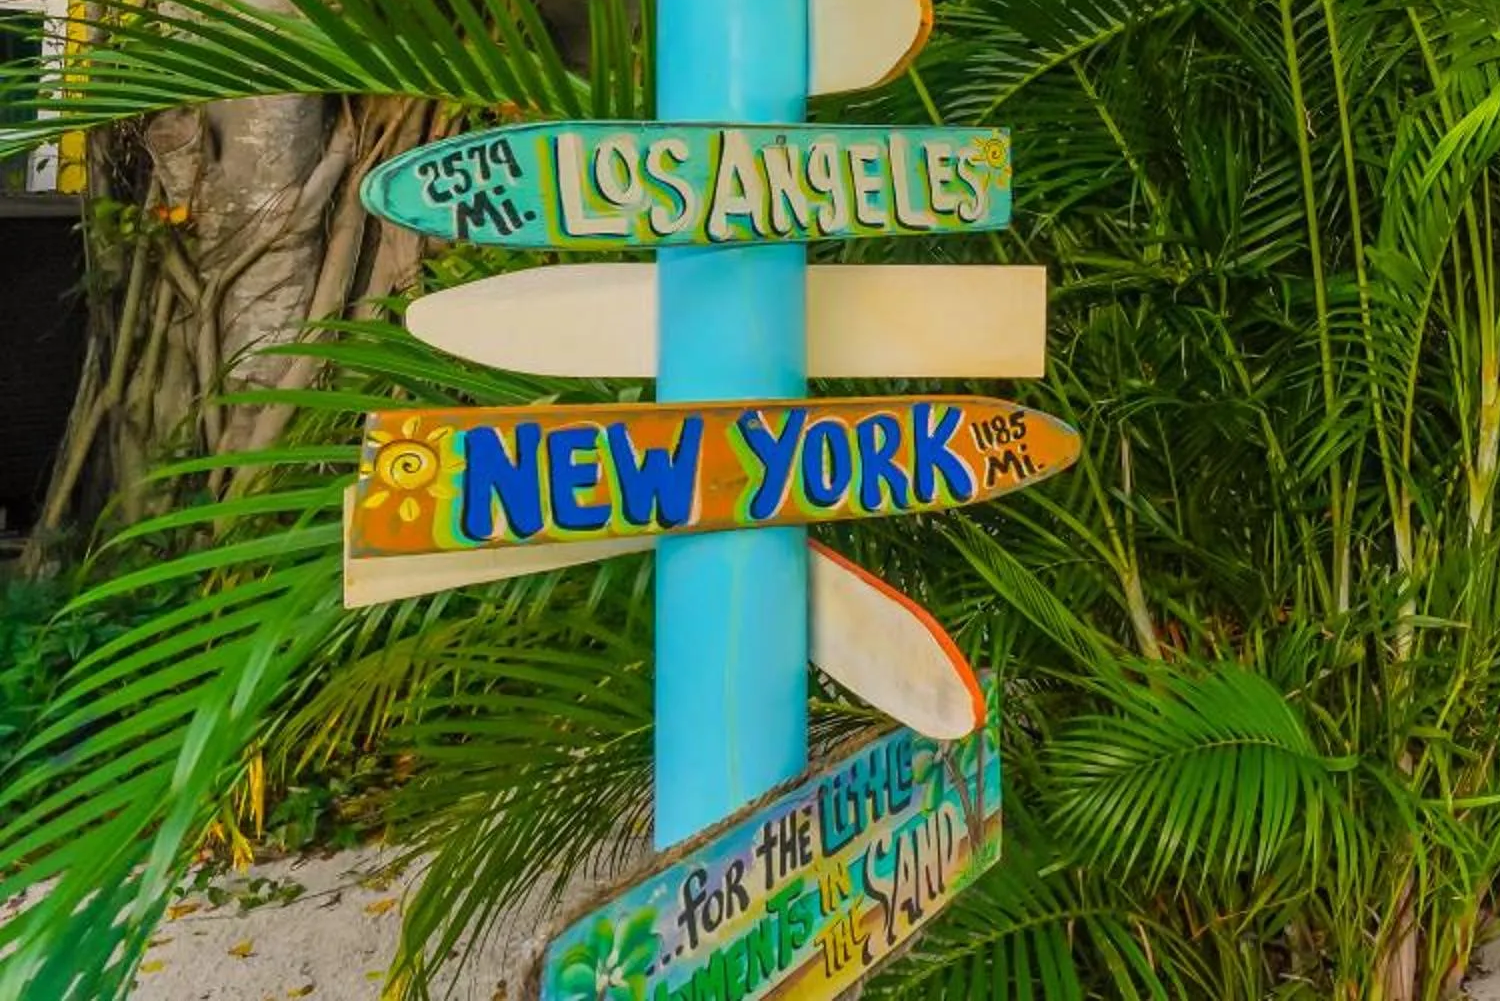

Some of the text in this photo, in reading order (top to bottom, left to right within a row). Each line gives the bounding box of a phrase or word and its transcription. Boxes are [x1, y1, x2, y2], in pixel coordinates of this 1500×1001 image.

[416, 137, 523, 206] 2579
[552, 132, 690, 237] LOS
[460, 402, 977, 540] NEW YORK
[969, 409, 1027, 454] 1185
[862, 799, 960, 966] SAND
